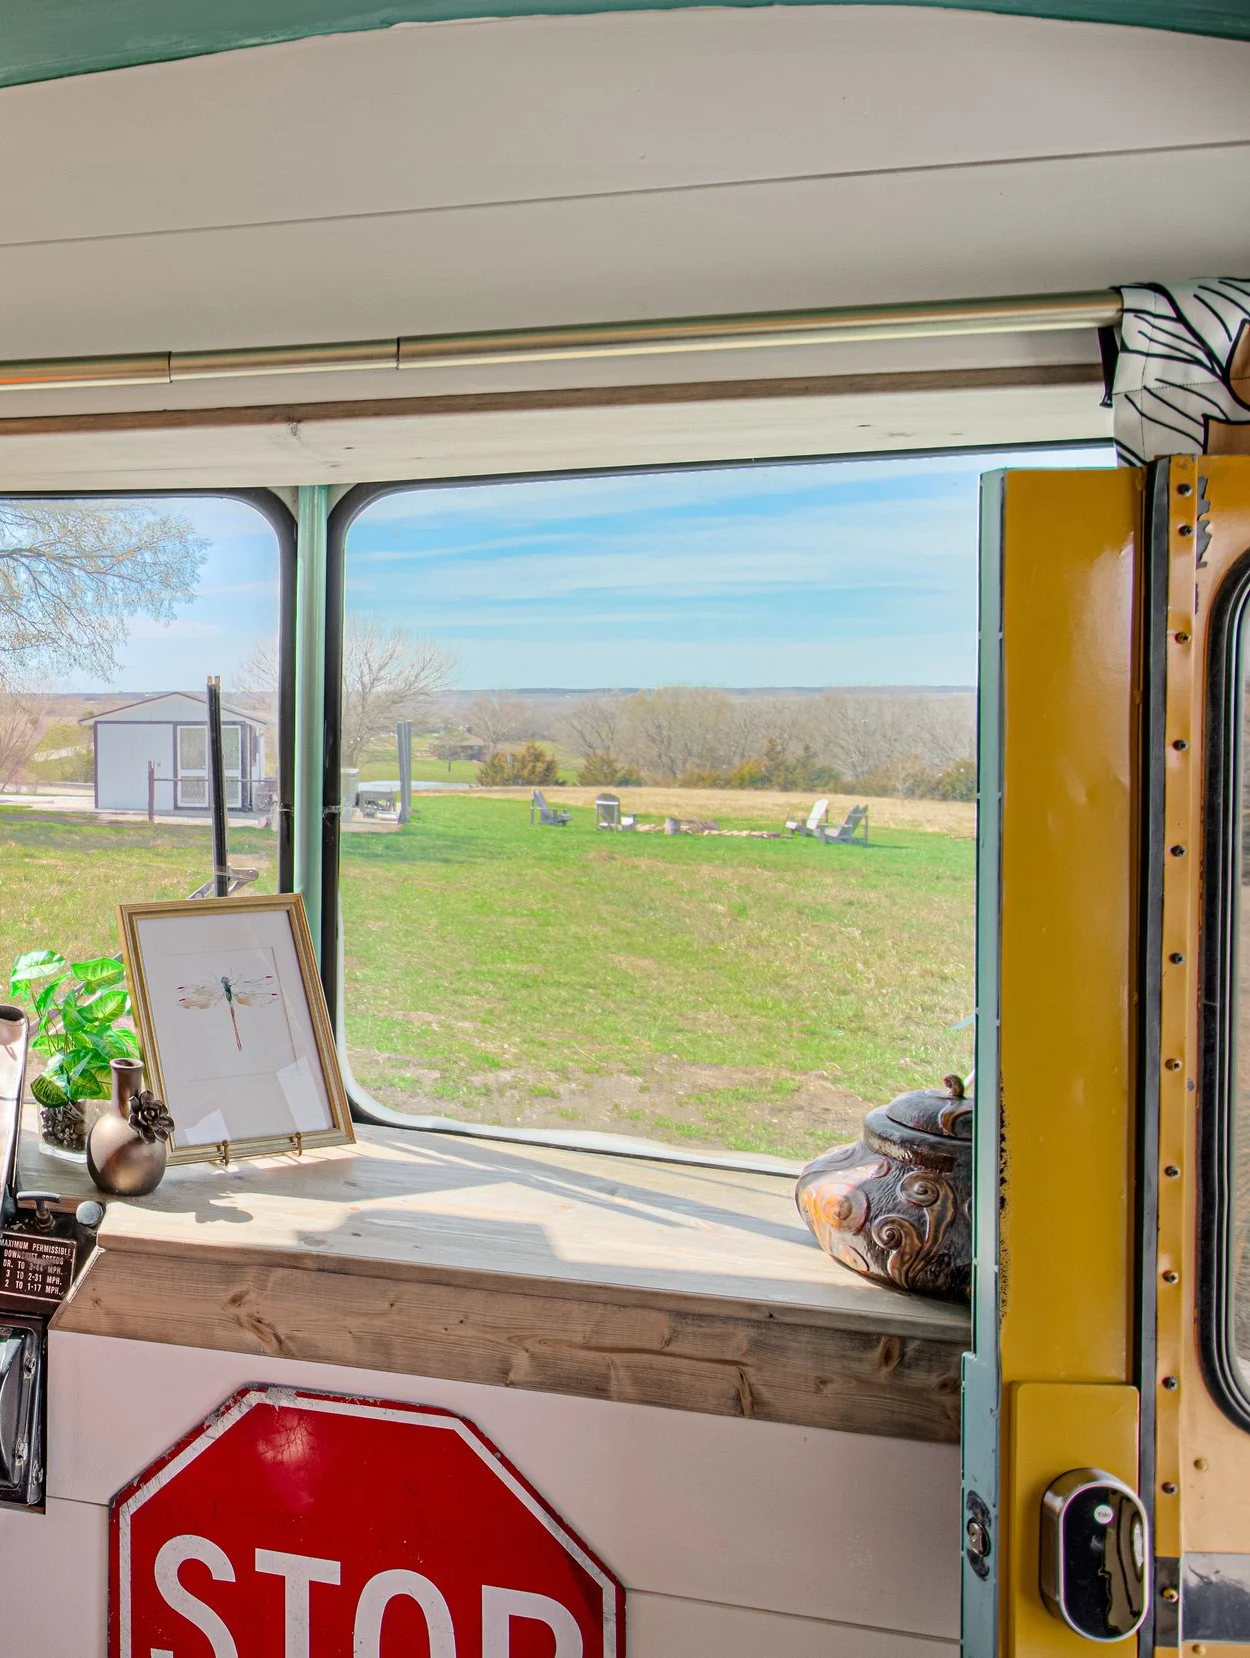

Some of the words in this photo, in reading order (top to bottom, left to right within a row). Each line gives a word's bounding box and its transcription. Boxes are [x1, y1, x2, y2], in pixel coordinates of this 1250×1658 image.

[0, 1239, 29, 1250] MAXIMUM
[32, 1243, 71, 1256] PERMISSIBLE
[3, 1259, 13, 1268] DR.
[18, 1261, 25, 1270] TO
[47, 1266, 63, 1275] MPH.
[42, 1254, 64, 1265] SPEEDS
[6, 1269, 10, 1277] 3
[17, 1271, 24, 1280] TO
[28, 1273, 42, 1282] 2-31
[46, 1275, 62, 1286] MPH.
[5, 1279, 9, 1287] 2
[15, 1281, 23, 1289] TO
[27, 1283, 42, 1292] 1-17
[45, 1285, 61, 1296] MPH.
